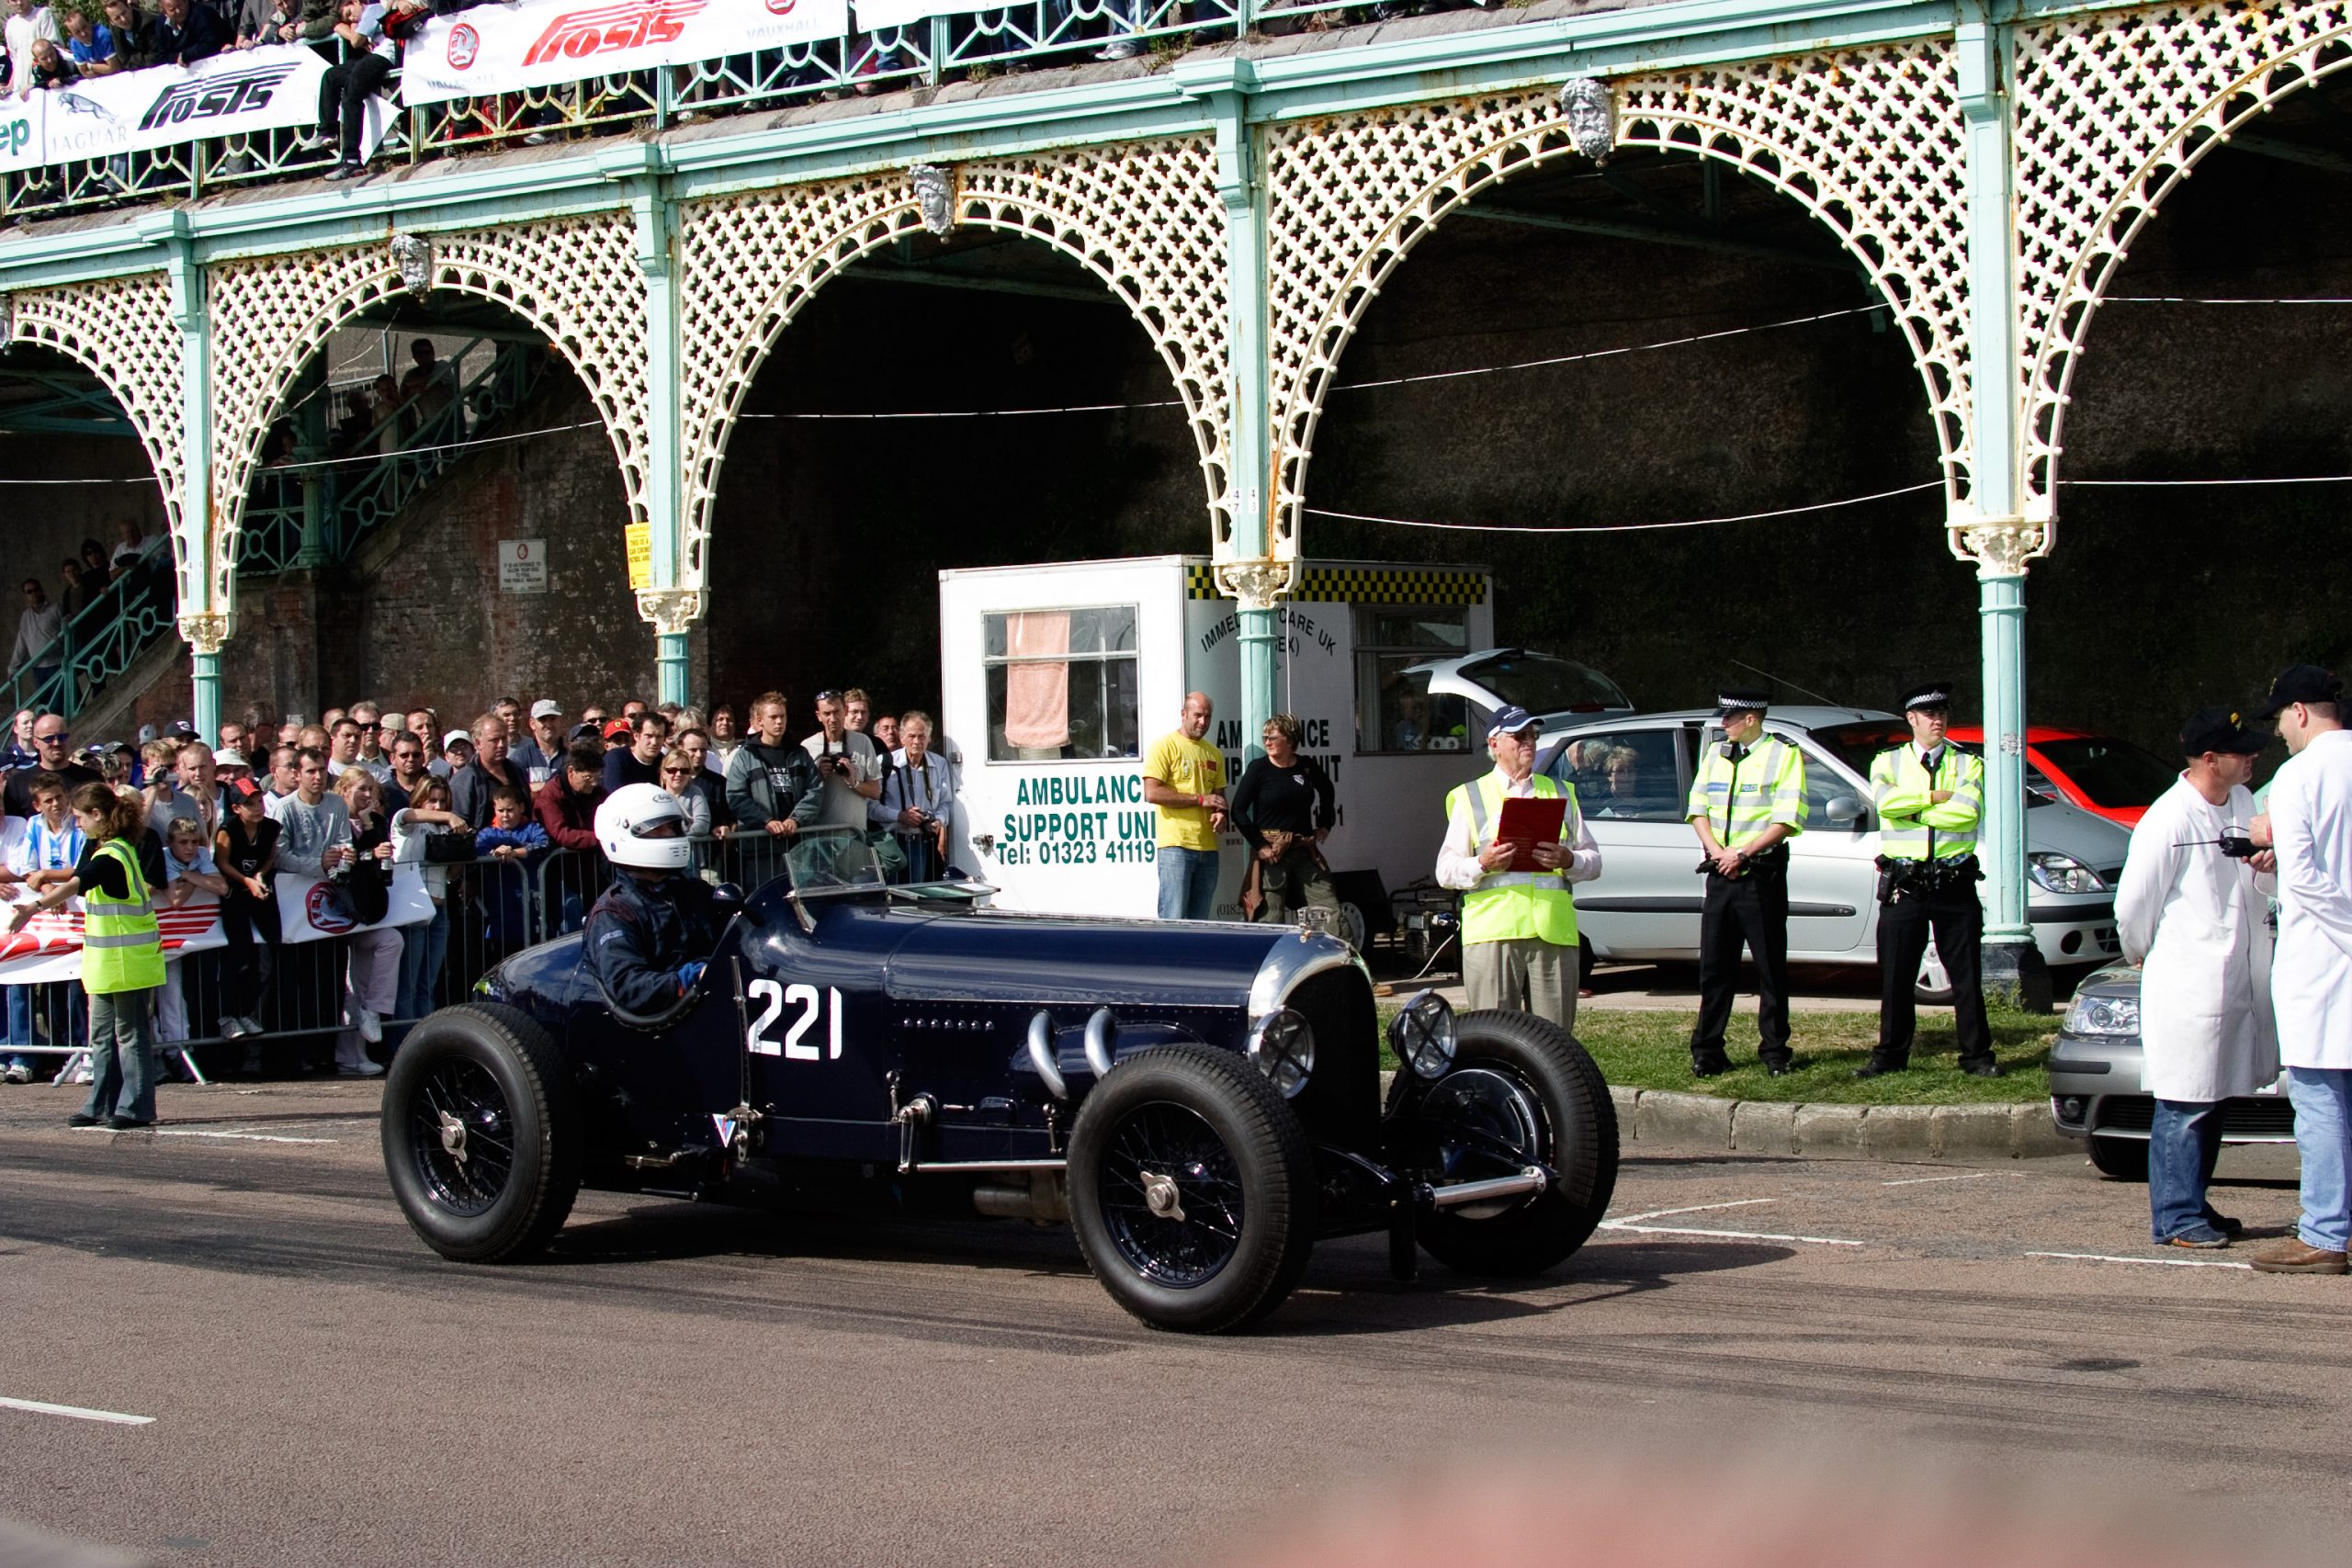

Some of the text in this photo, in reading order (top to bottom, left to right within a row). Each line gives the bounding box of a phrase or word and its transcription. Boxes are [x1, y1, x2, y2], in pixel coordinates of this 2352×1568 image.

[747, 17, 822, 39] VAUXHALL
[52, 126, 128, 153] JAGUAR
[1278, 607, 1315, 637] CARE
[1317, 629, 1337, 657] UK
[1017, 774, 1148, 806] AMBULANC
[1004, 810, 1157, 842] SUPPORT UNI
[996, 840, 1156, 864] Tel: 01323 41119
[748, 978, 842, 1061] 221
